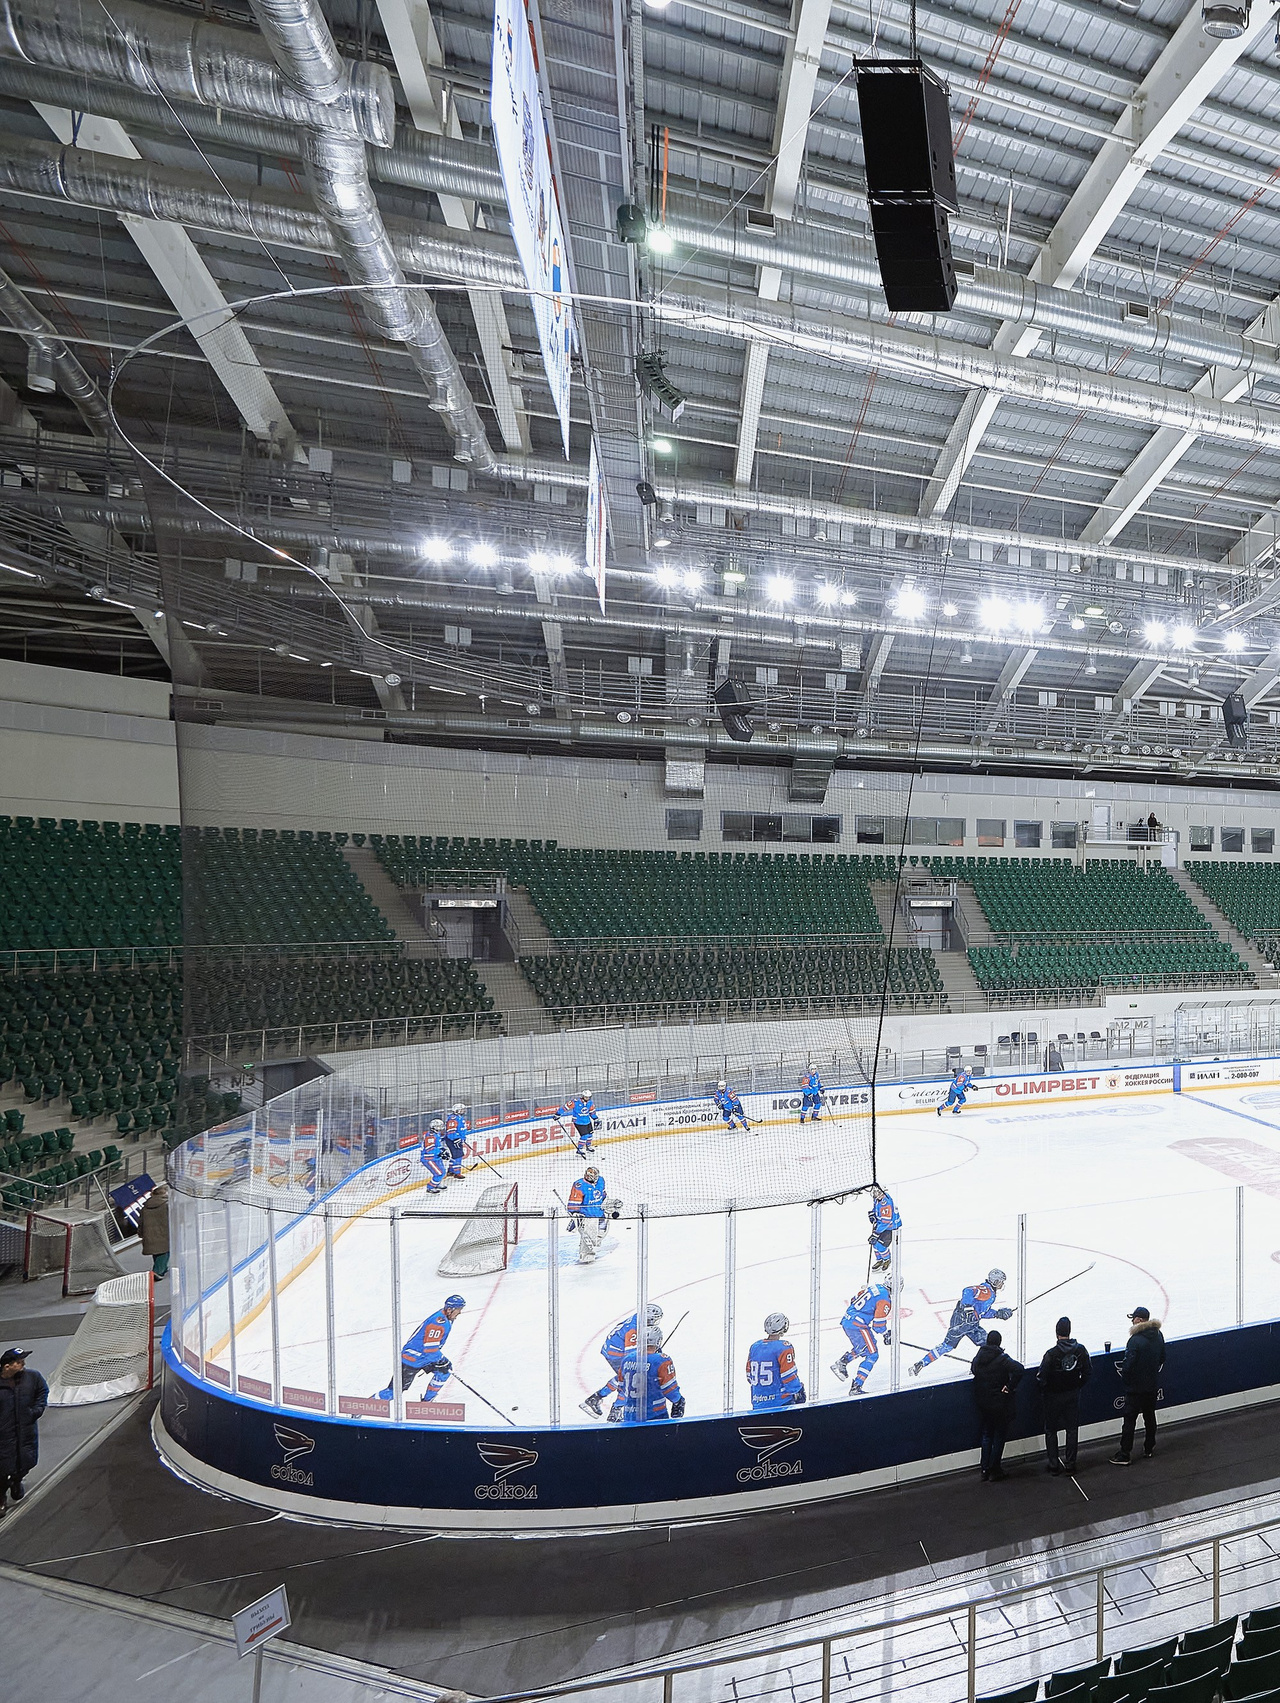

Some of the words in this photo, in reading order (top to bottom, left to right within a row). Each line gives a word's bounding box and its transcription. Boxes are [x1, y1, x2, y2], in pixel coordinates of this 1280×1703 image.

[995, 1077, 1100, 1096] OLIMPBET
[606, 1117, 646, 1131] ИЛАН
[668, 1112, 719, 1126] 2-000-007
[386, 1164, 411, 1181] SINTEC
[428, 1329, 441, 1339] 80
[750, 1361, 773, 1386] 95
